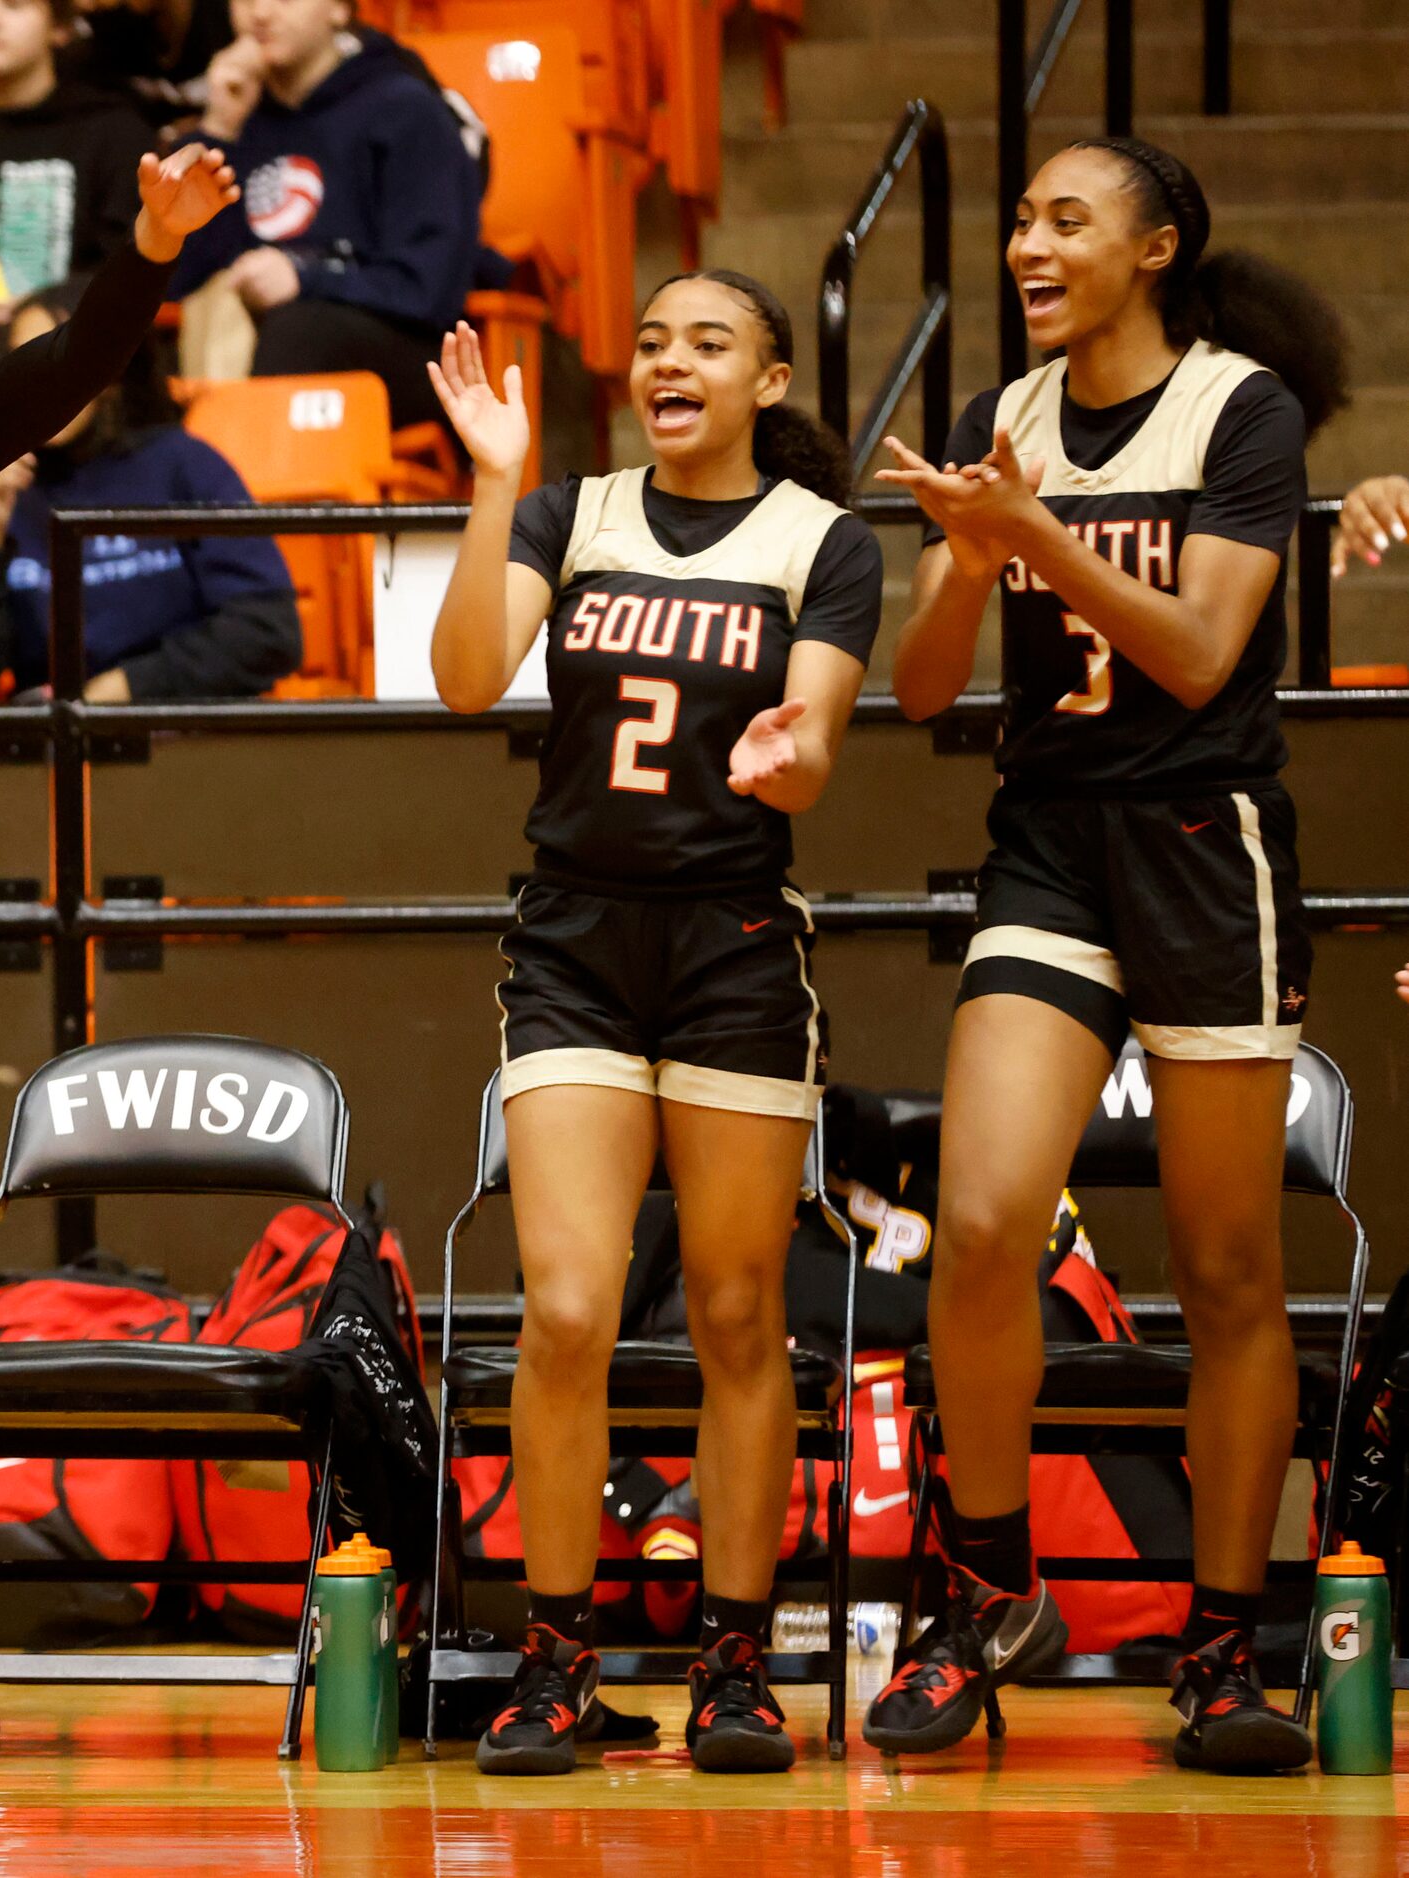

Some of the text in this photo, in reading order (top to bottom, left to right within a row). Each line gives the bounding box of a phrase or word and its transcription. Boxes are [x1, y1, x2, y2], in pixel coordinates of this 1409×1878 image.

[563, 591, 763, 672] SOUTH
[1053, 610, 1114, 717] 3
[608, 673, 681, 796] 2
[46, 1068, 310, 1143] FWISD
[1320, 1610, 1360, 1662] G
